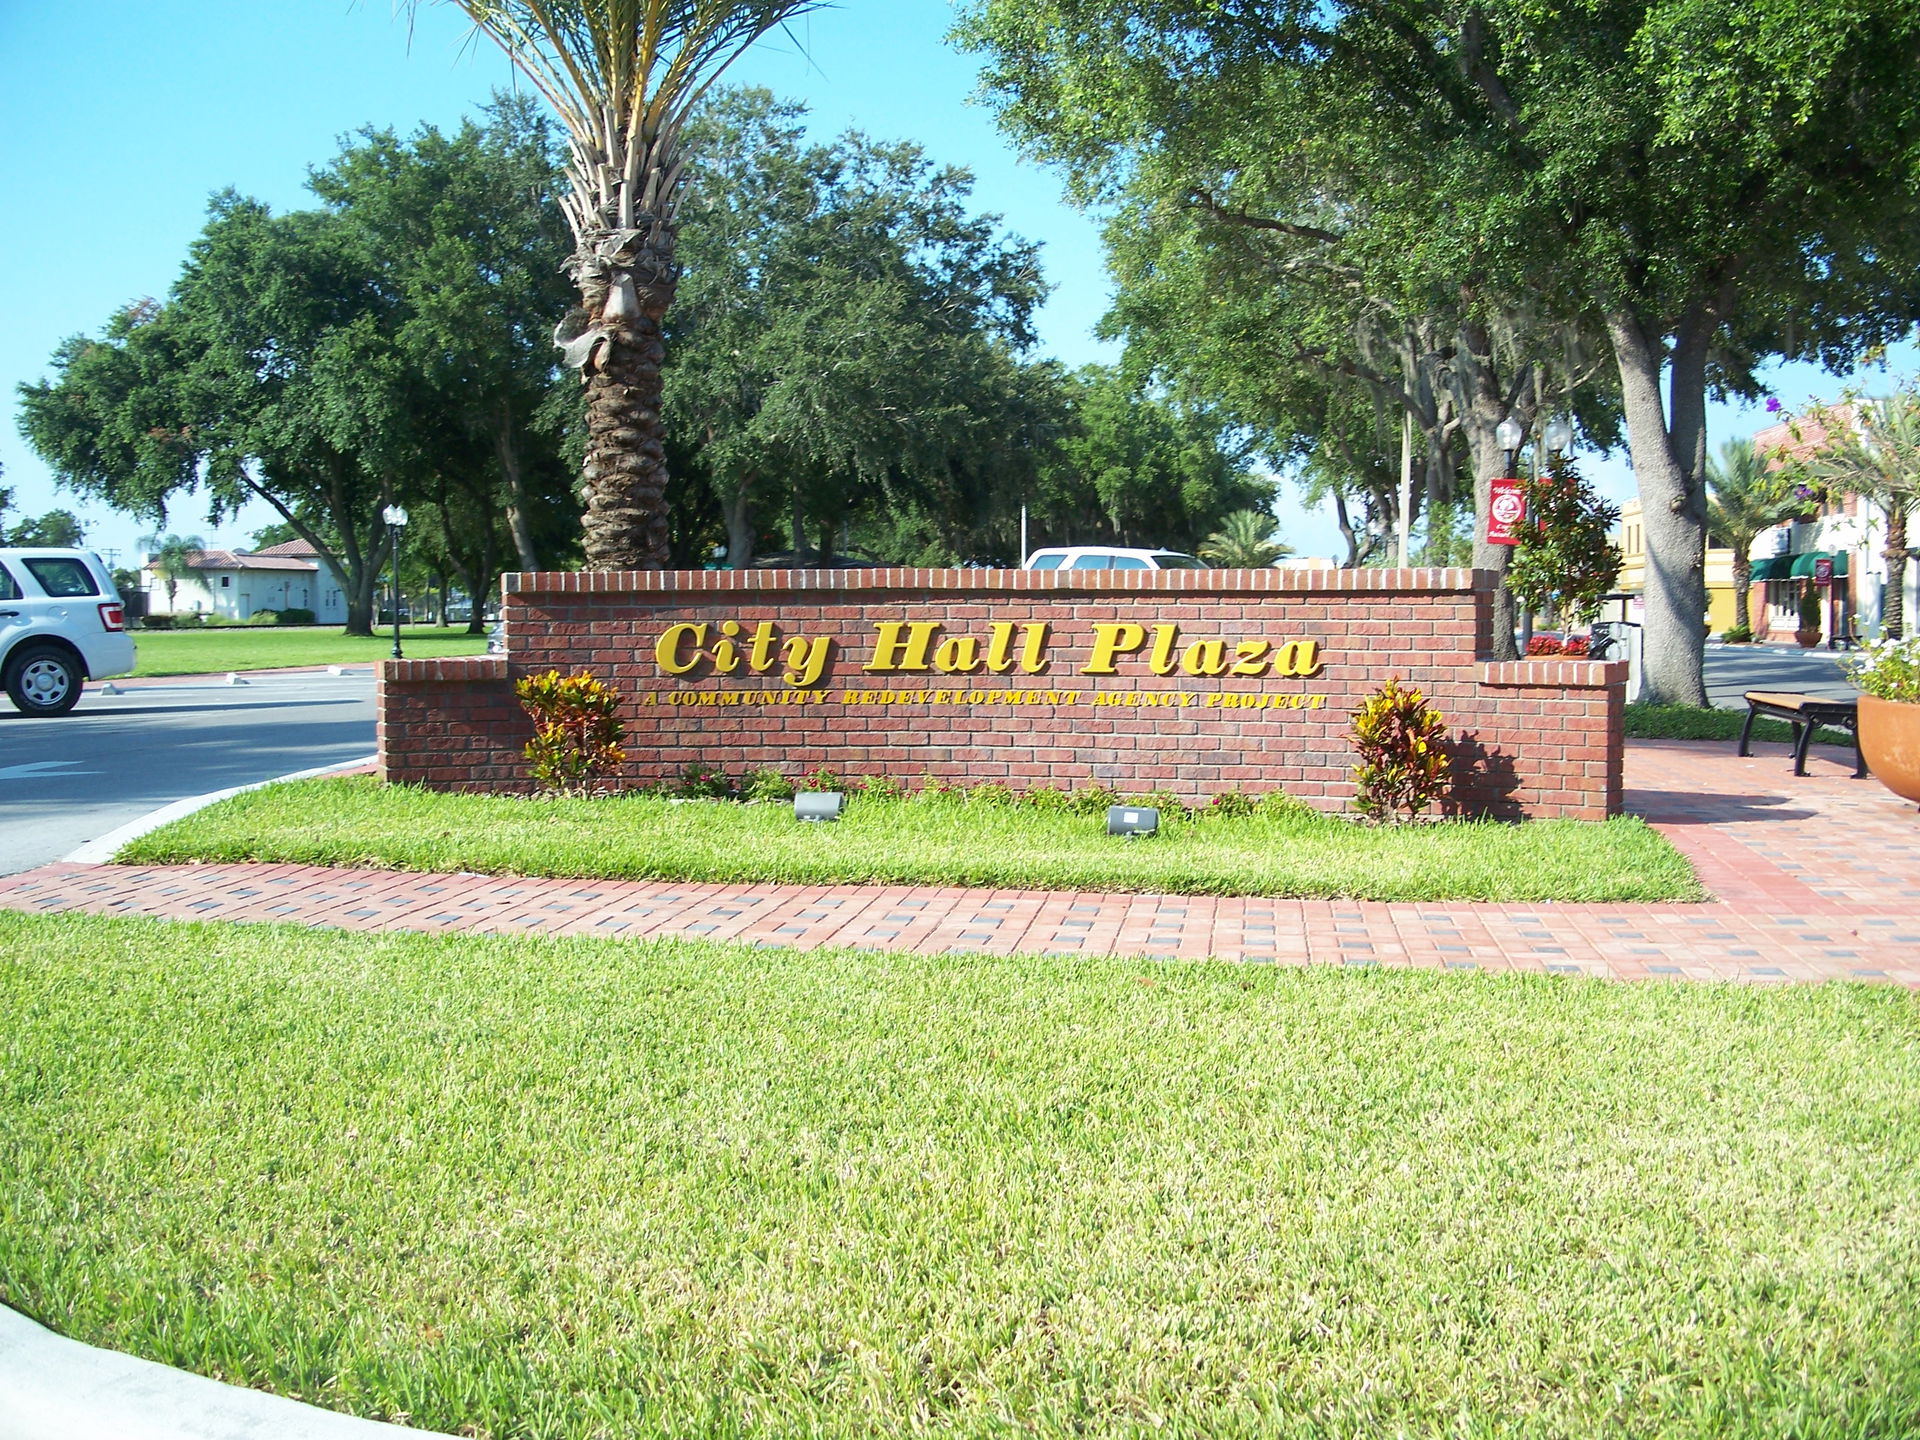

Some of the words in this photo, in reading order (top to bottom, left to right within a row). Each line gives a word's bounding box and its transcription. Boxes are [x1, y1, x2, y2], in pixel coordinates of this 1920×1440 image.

[655, 620, 832, 687] City
[862, 621, 1047, 673] Hall
[1079, 622, 1325, 676] Plaza
[643, 691, 658, 706] A
[668, 690, 831, 706] COMMUNITY
[844, 690, 1081, 706] REDEVELOPMENT
[1092, 691, 1199, 708] AGENCY
[1205, 691, 1328, 709] PROJECT
